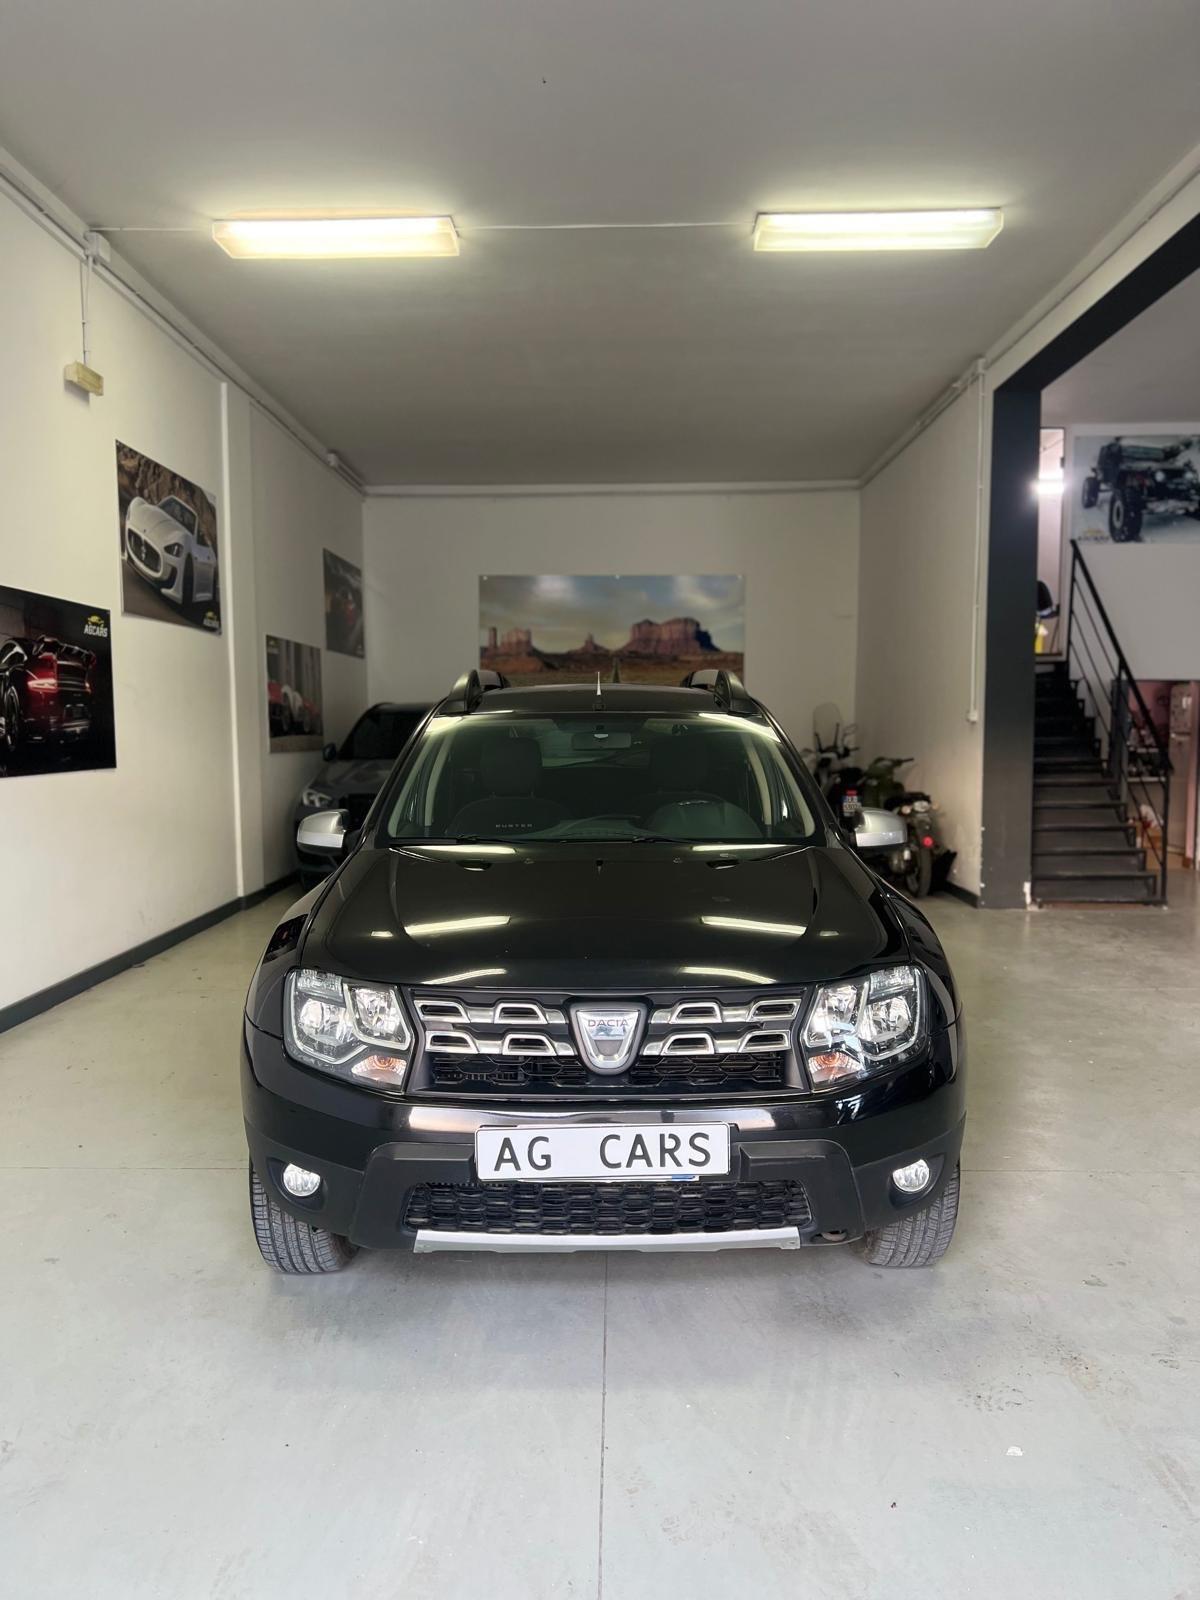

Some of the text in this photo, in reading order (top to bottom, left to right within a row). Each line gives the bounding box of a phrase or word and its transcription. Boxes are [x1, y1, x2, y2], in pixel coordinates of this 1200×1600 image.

[83, 624, 108, 638] AGCARS
[588, 1019, 629, 1027] DACIA
[494, 1132, 711, 1172] AG CARS
